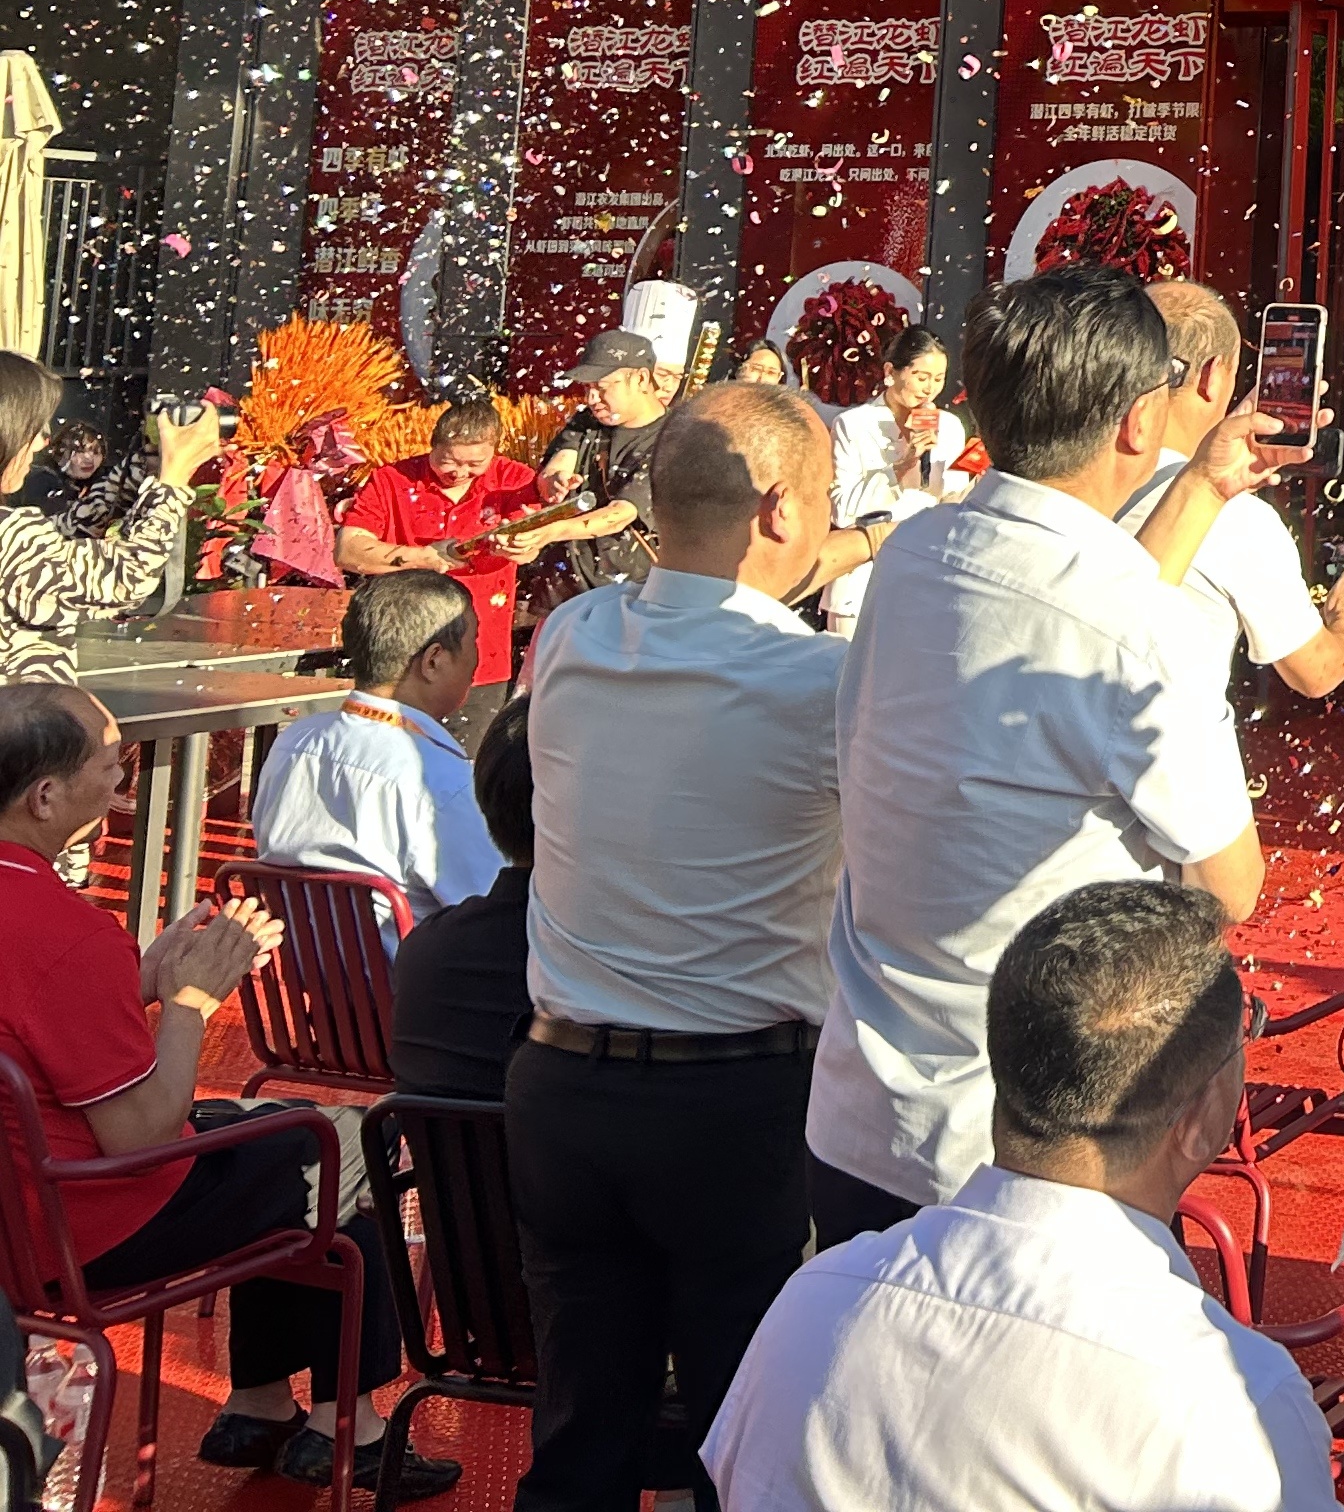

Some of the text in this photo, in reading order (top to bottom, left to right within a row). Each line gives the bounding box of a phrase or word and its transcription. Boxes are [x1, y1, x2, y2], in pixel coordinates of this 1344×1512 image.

[1049, 12, 1208, 46] 潜江龙虾
[1047, 48, 1206, 81] 红遍天下
[1030, 102, 1201, 119] 潜江四季有虾，打破季节限
